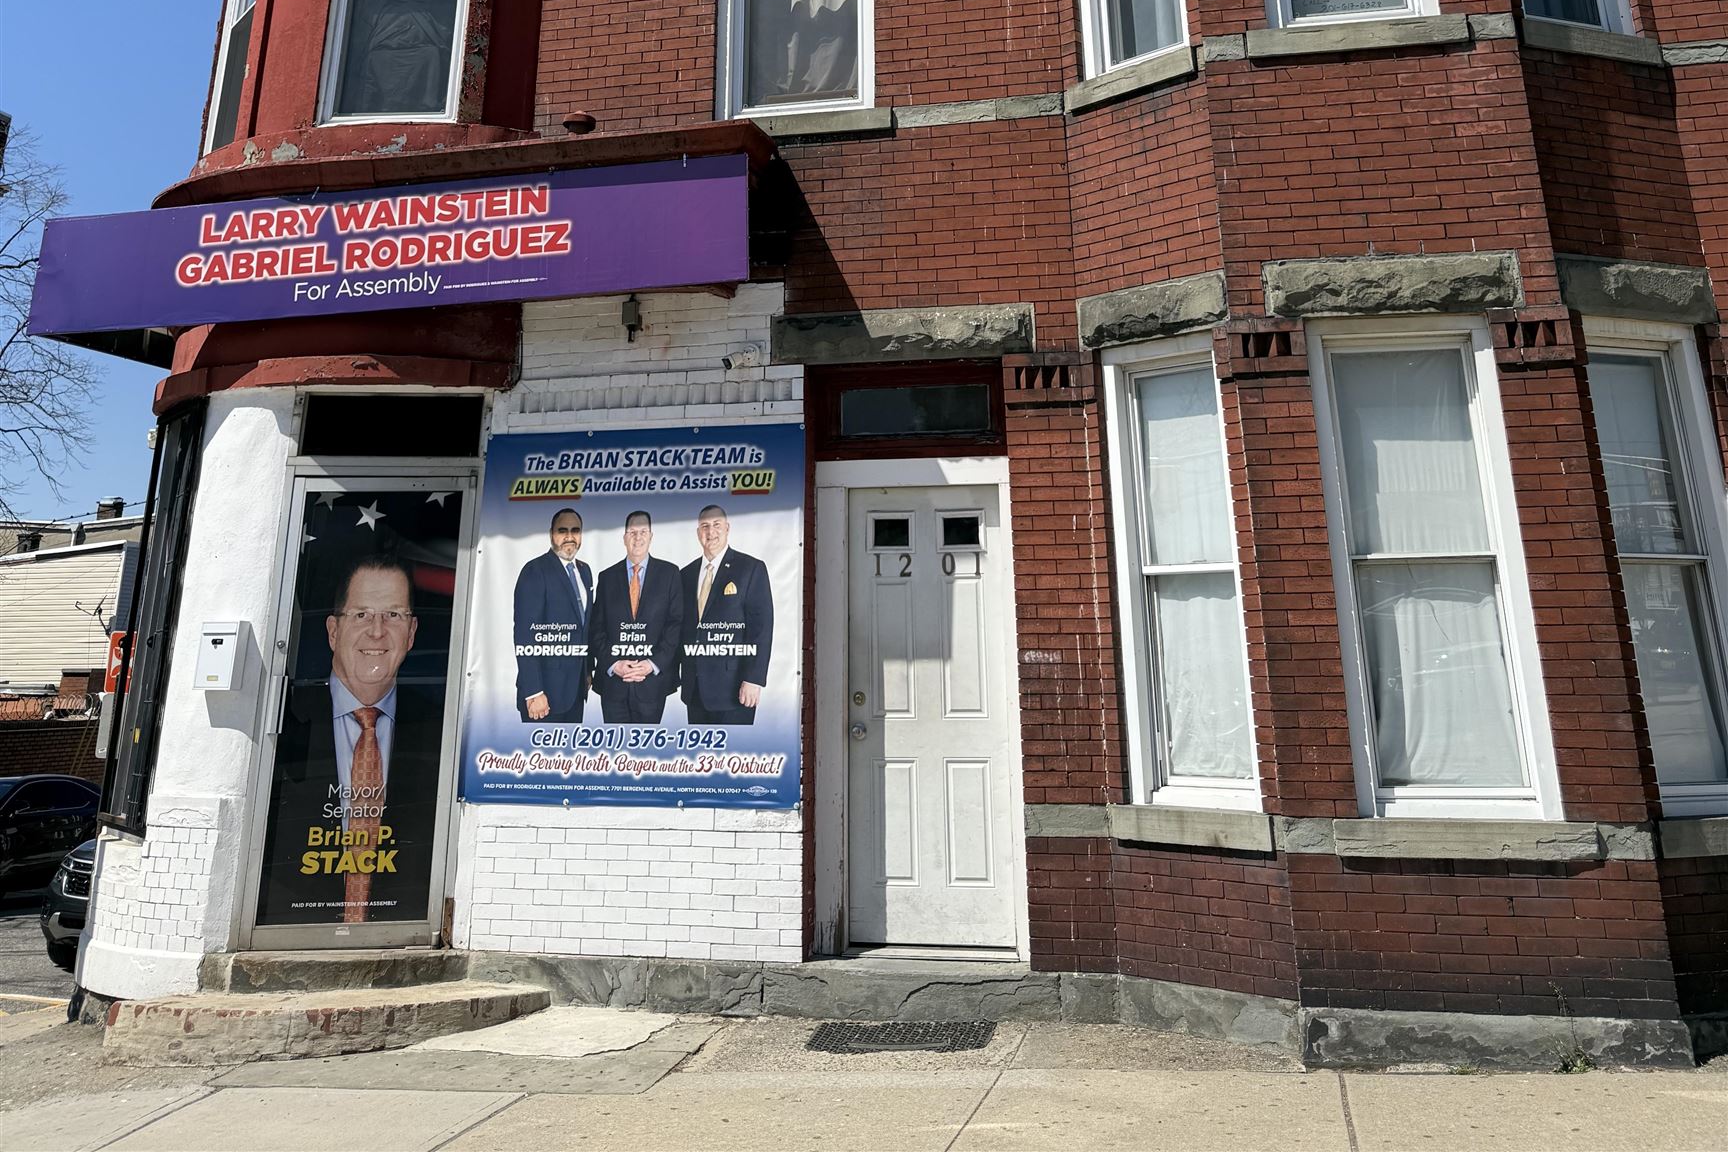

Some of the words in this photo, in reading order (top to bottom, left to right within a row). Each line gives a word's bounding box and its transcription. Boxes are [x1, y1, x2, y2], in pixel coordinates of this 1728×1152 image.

[202, 206, 325, 244] LARRY
[334, 185, 548, 233] WAINSTEIN
[178, 245, 336, 285] GABRIEL
[345, 223, 569, 271] RODRIGUEZ
[294, 282, 330, 302] For
[335, 271, 442, 298] Assembly
[527, 456, 555, 471] The
[558, 451, 620, 470] BRIAN
[622, 449, 686, 468] STACK
[690, 447, 746, 465] TEAM
[749, 448, 762, 463] is
[513, 478, 580, 495] ALWAYS
[581, 476, 657, 493] Available
[660, 477, 677, 490] to
[679, 474, 727, 489] Assist
[731, 472, 773, 488] YOU!
[873, 551, 982, 578] 1201
[529, 622, 577, 631] Assemblyman
[620, 622, 647, 630] Senator
[696, 621, 746, 631] Assemblyman
[534, 632, 571, 642] Gabriel
[619, 632, 647, 642] Brian
[707, 631, 734, 643] Larry
[515, 644, 589, 656] RODRIGUEZ
[611, 644, 653, 656] STACK
[683, 644, 757, 656] WAINSTEIN
[531, 729, 568, 747] Cell:
[572, 726, 624, 749] (201)
[628, 729, 727, 748] 376-1942
[479, 752, 527, 773] Proudly
[529, 752, 572, 774] Serving
[575, 753, 611, 771] North
[614, 753, 658, 776] Bergen
[659, 759, 679, 772] and
[679, 757, 694, 773] the
[695, 755, 726, 773] 33rd
[727, 755, 784, 774] District!
[327, 783, 386, 801] Mayor/
[322, 802, 388, 819] Senator
[307, 825, 370, 847] Brian
[377, 825, 396, 846] P.
[299, 849, 399, 875] STACK
